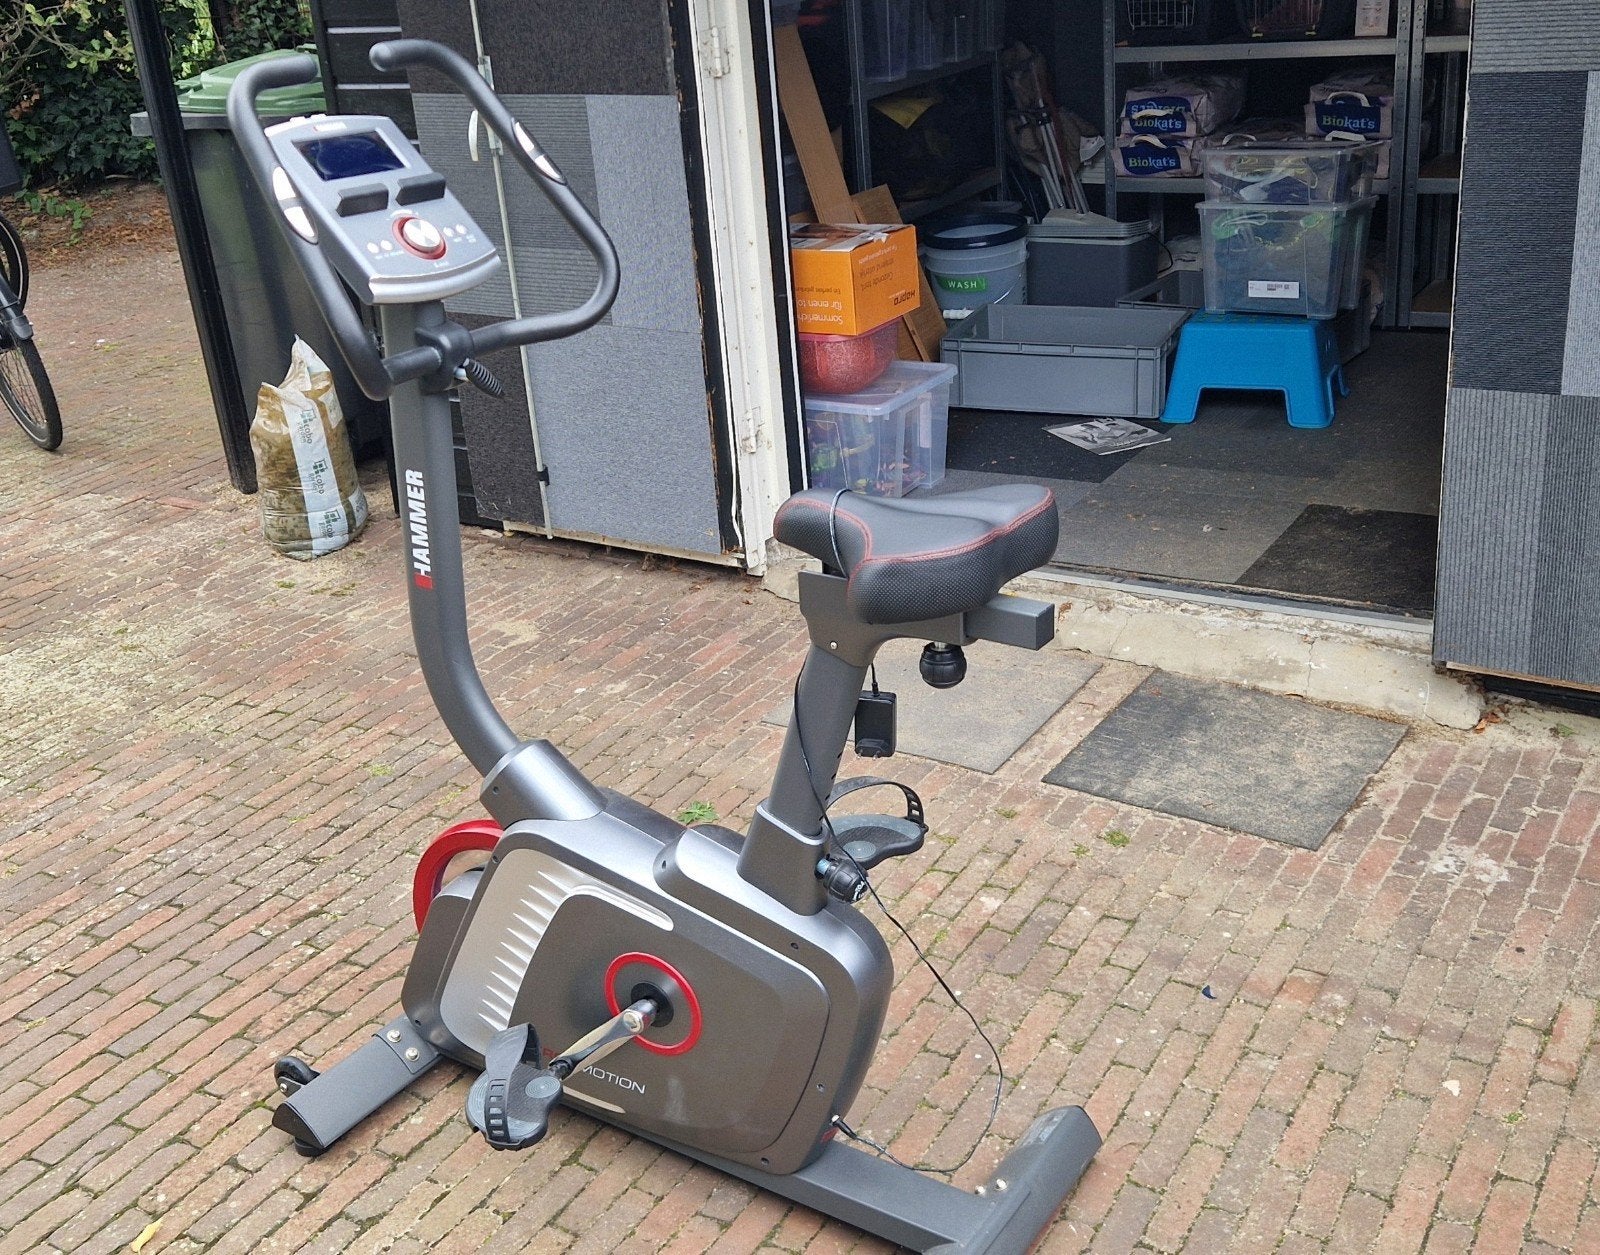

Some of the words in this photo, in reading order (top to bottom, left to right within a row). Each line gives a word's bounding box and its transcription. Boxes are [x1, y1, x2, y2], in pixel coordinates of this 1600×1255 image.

[1322, 114, 1375, 131] Biokat's
[1128, 156, 1176, 169] Biokat's
[948, 280, 977, 289] WASH
[303, 424, 313, 444] cobo
[315, 474, 325, 494] cobo
[405, 469, 432, 588] HAMMER
